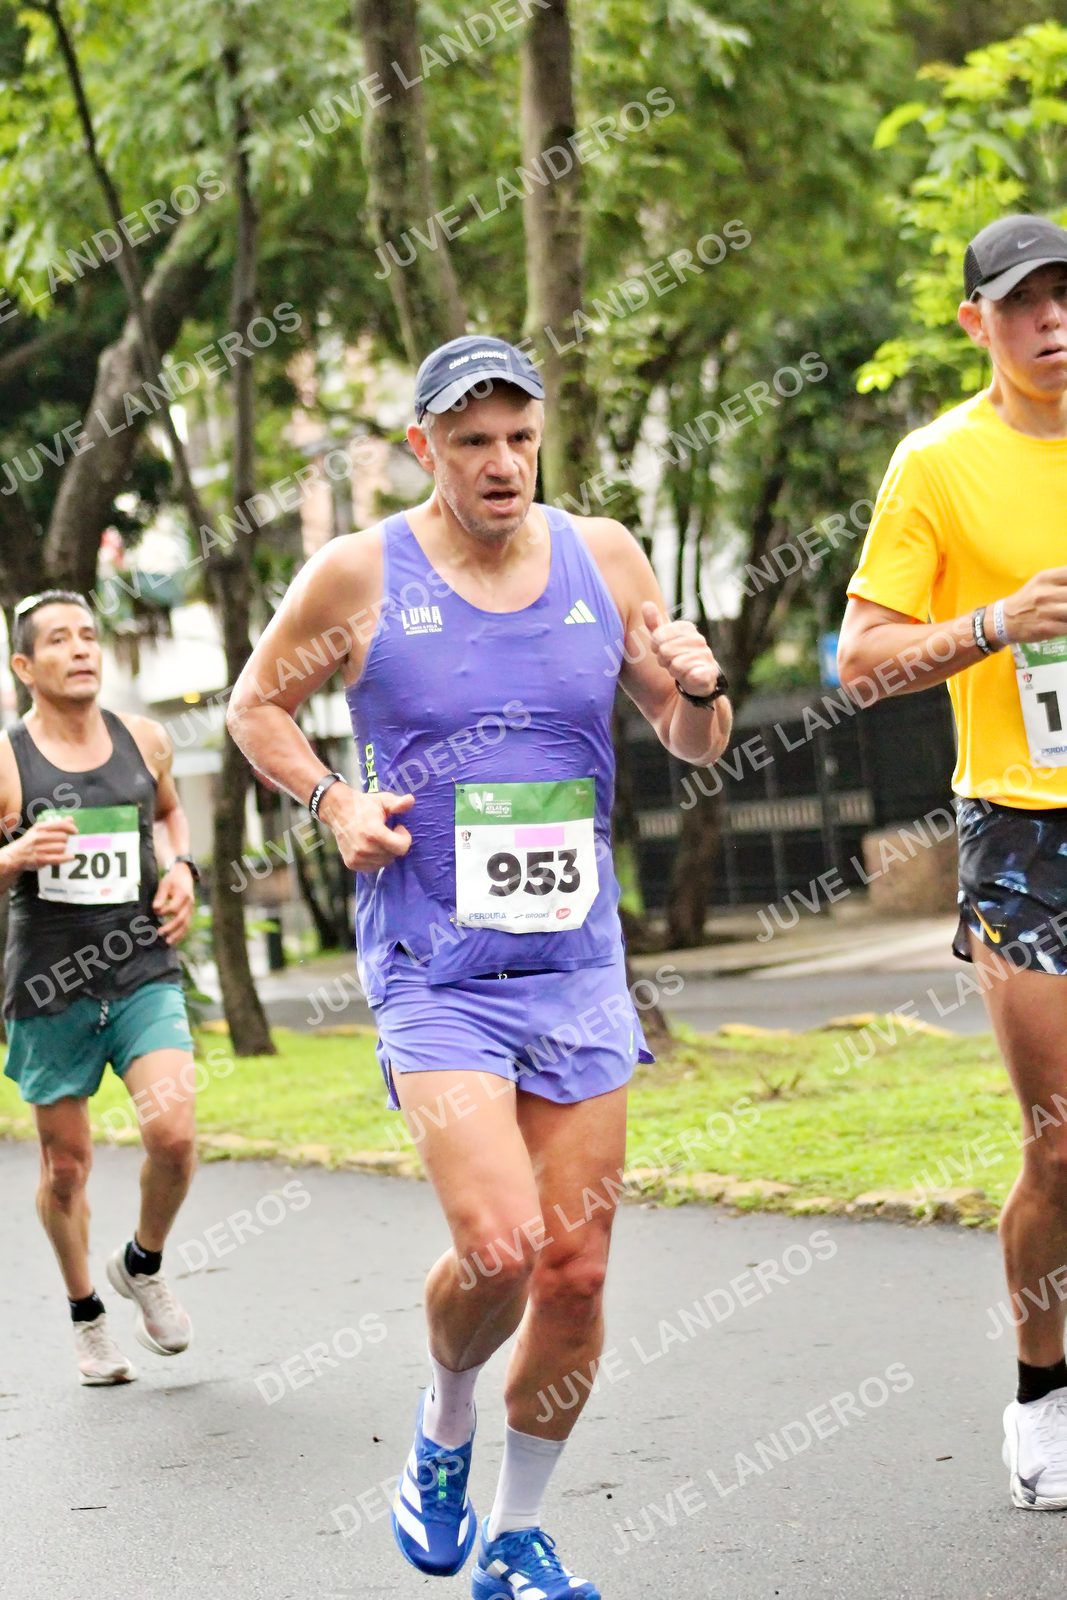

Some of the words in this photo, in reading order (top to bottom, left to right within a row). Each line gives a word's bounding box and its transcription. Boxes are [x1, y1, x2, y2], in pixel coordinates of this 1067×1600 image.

[401, 606, 443, 630] LUNA
[1036, 691, 1062, 733] 1
[487, 849, 580, 897] 953
[469, 912, 507, 920] PERDURA
